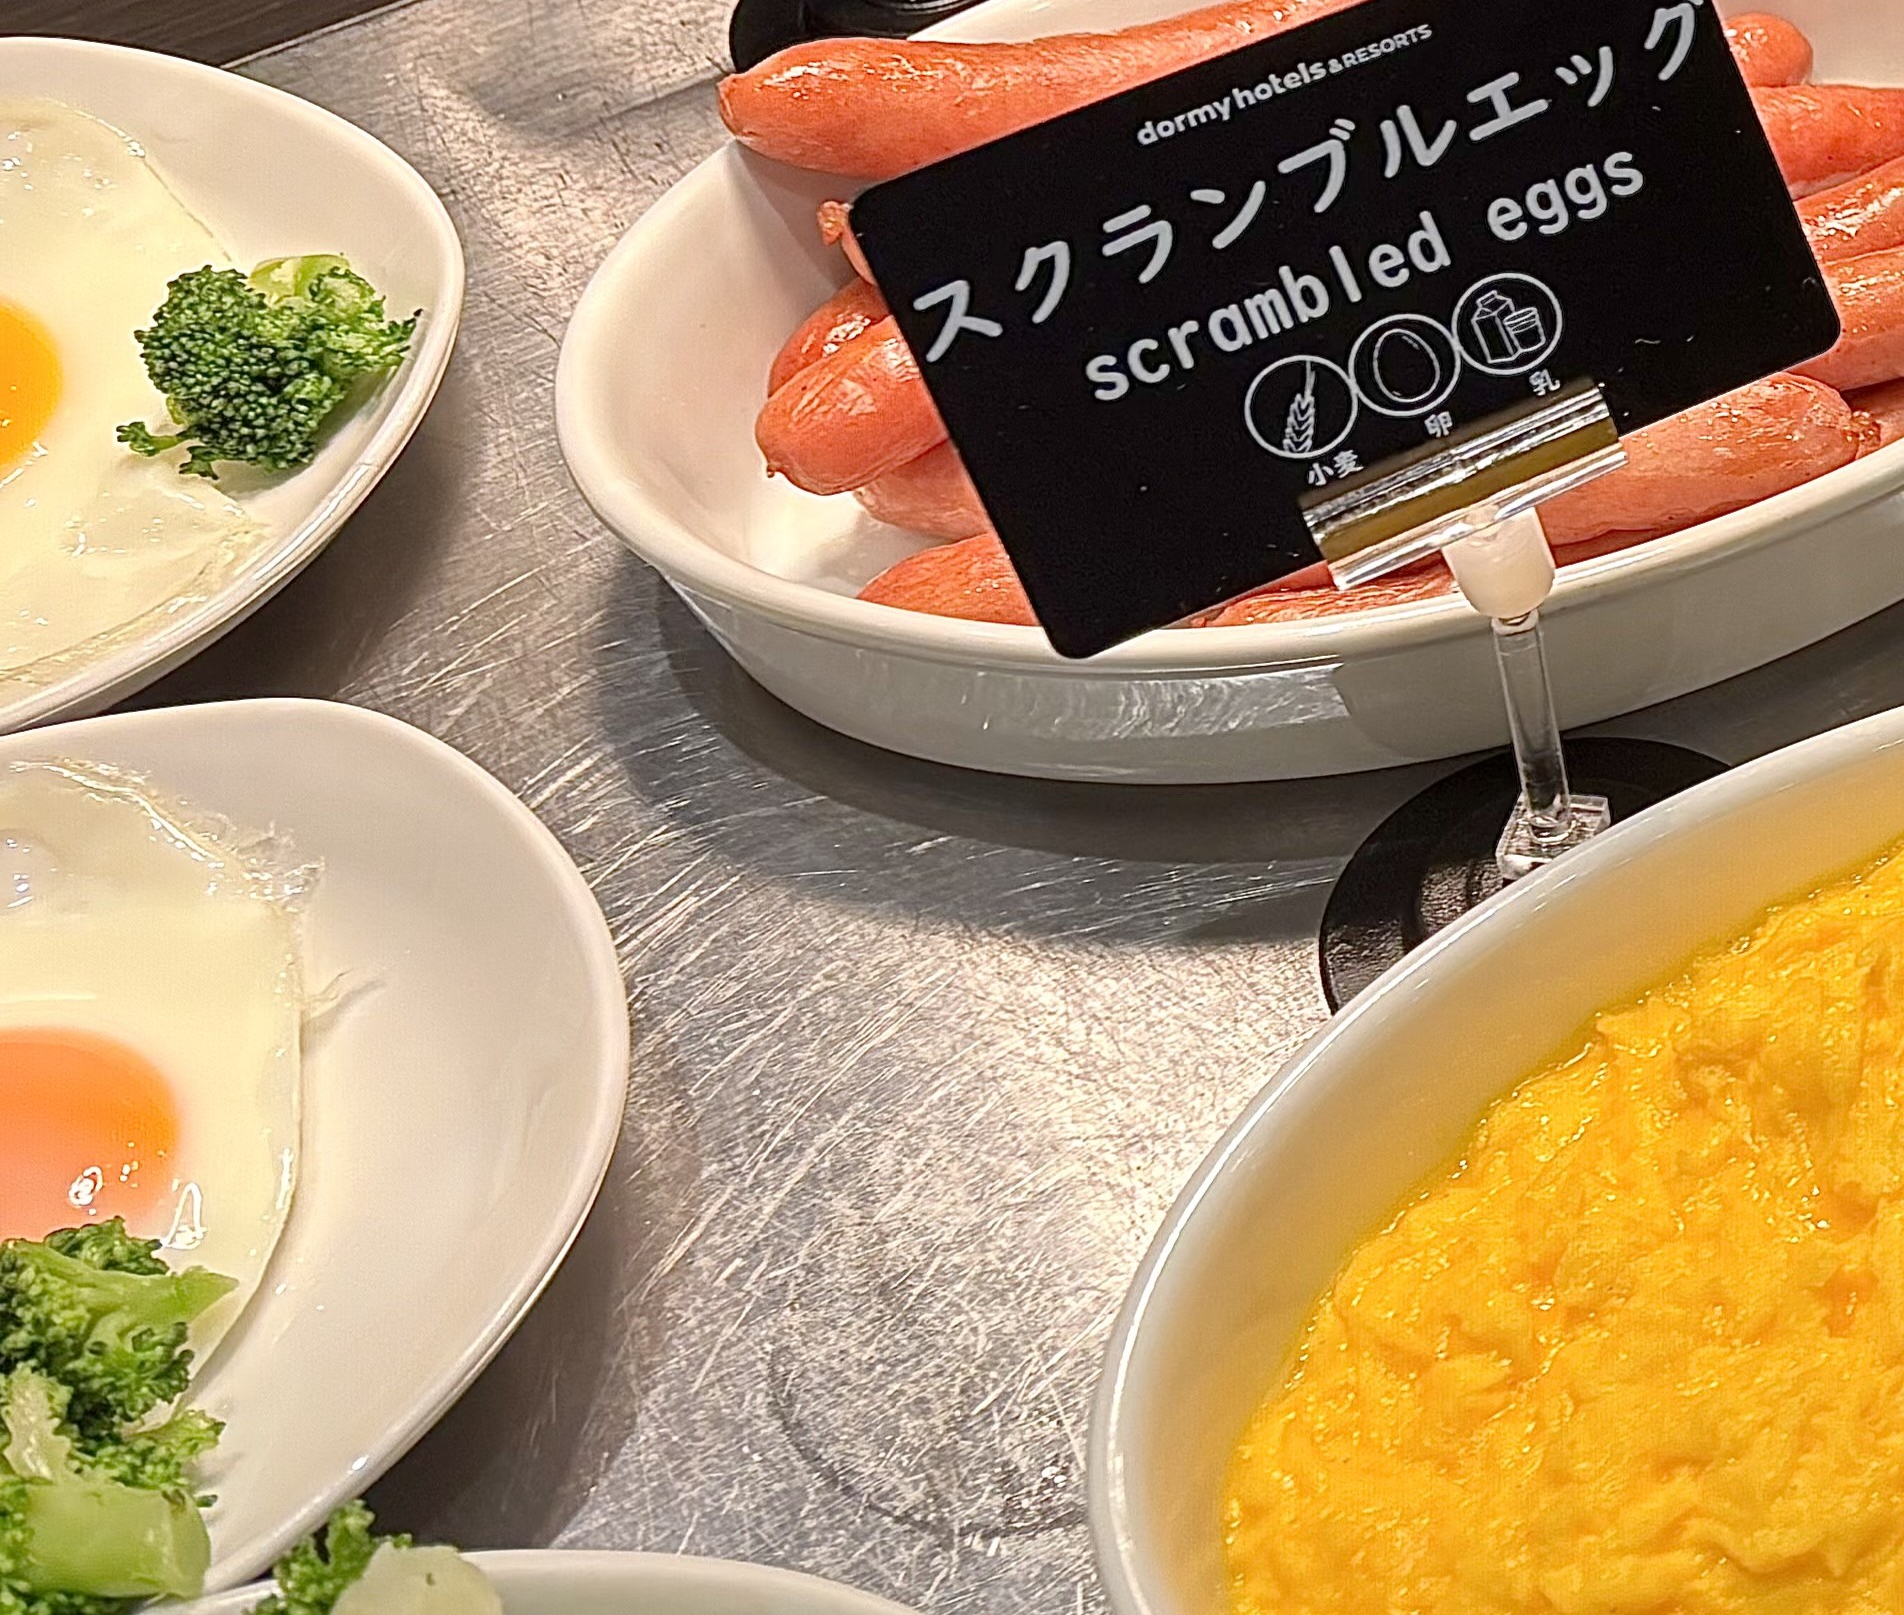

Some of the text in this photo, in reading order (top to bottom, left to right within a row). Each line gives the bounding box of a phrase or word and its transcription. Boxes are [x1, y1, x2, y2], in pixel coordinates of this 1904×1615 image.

[1084, 148, 1646, 402] scrambled eggs
[1306, 368, 1561, 487] 小麦 卵 乳
